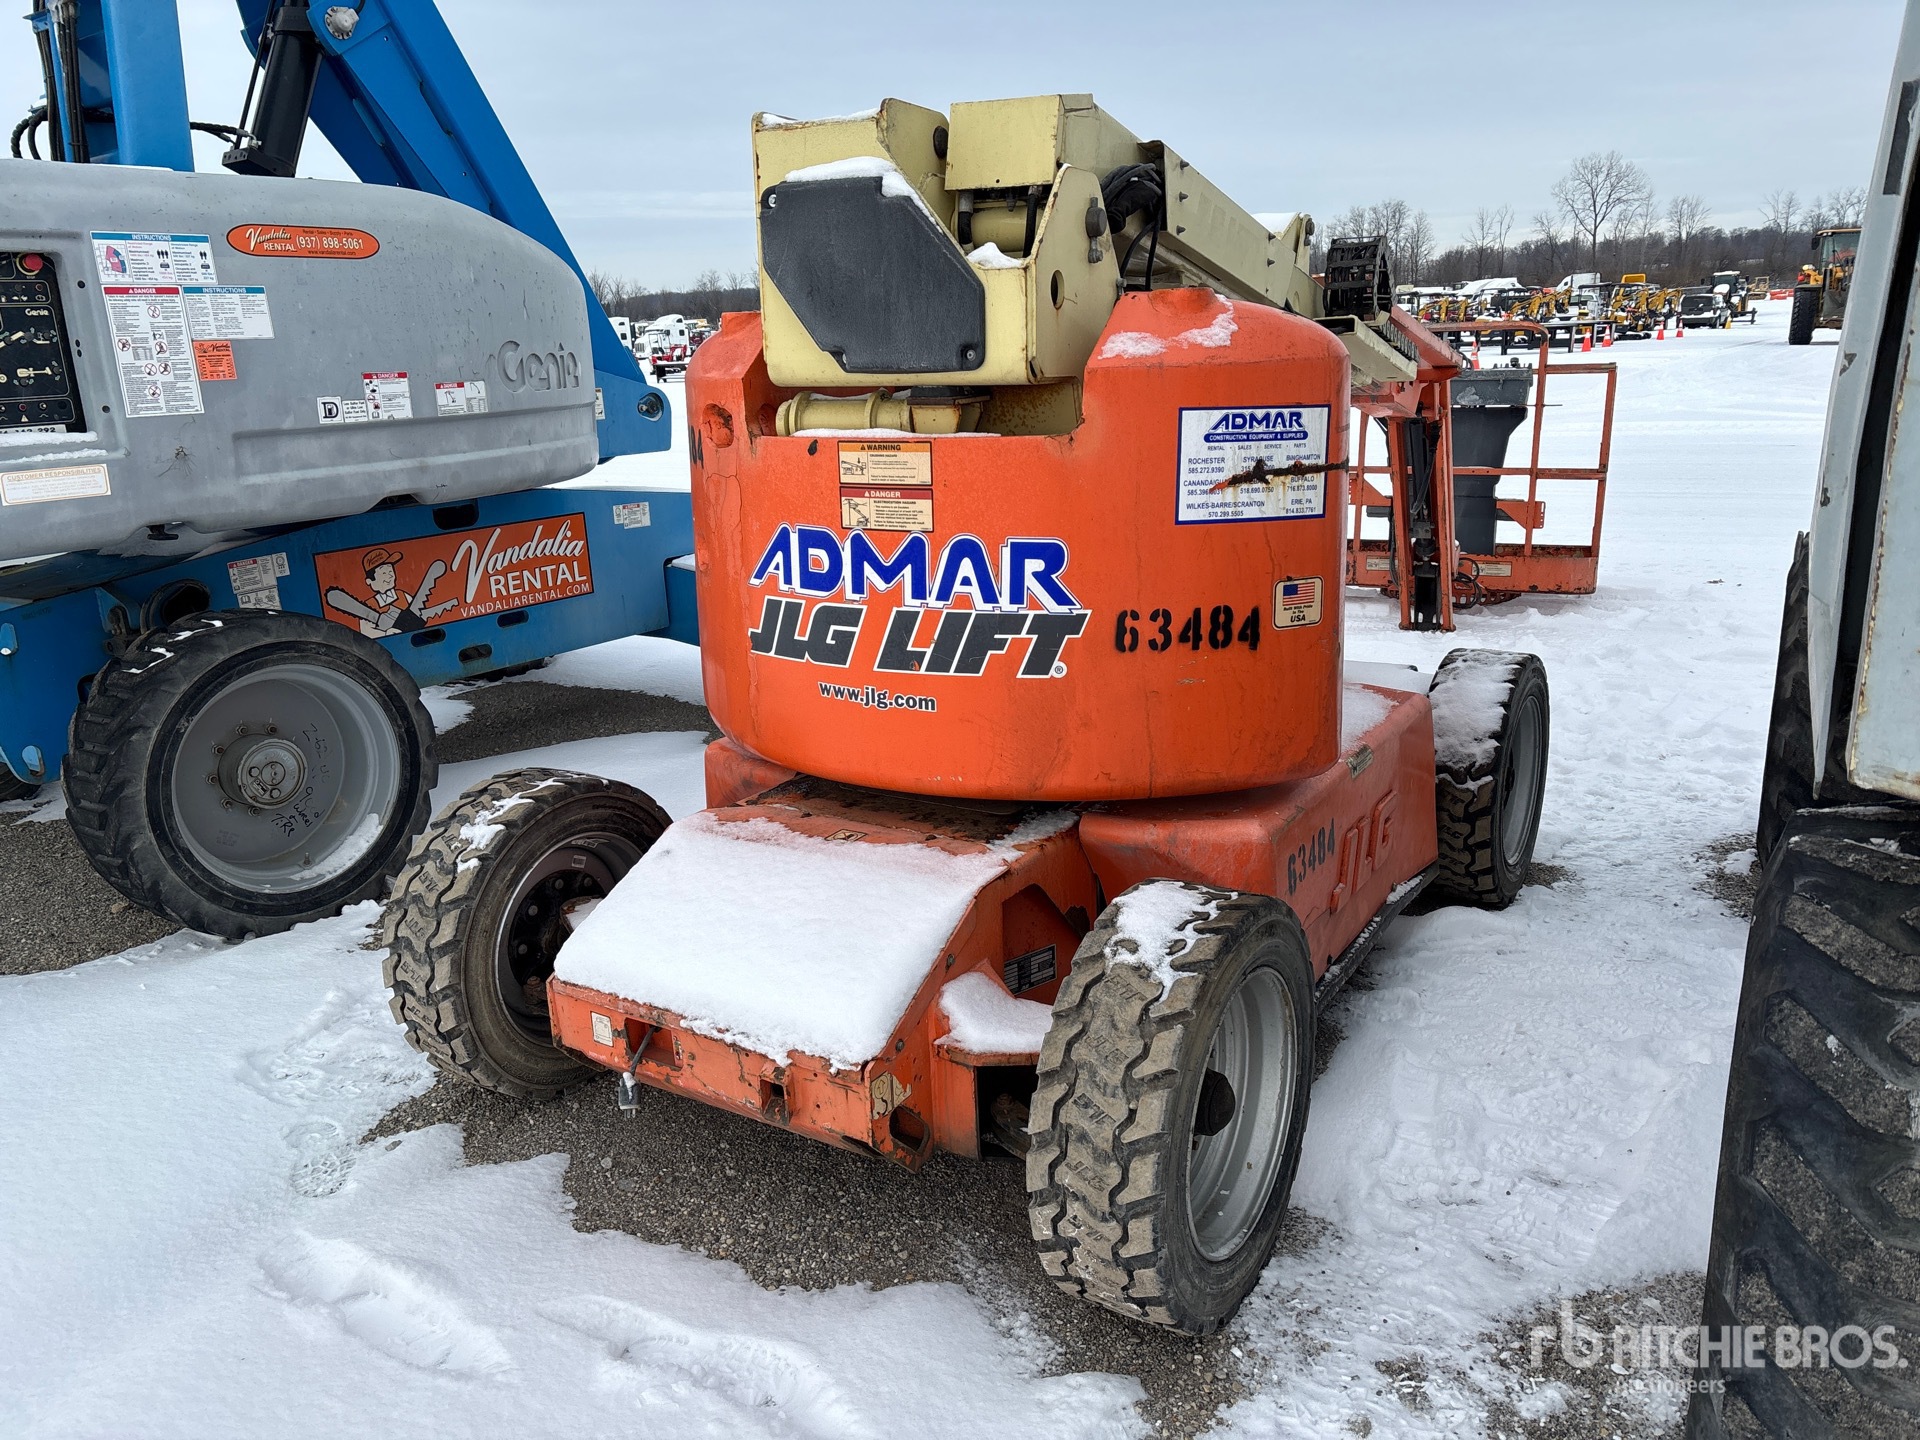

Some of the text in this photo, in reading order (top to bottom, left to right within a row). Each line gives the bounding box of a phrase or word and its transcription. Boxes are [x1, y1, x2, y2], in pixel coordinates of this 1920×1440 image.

[246, 227, 292, 251] Vandalia
[263, 242, 297, 252] RENTAL
[296, 234, 364, 250] (937) 898-5061
[25, 308, 50, 316] Genie
[497, 340, 580, 393] Genie
[1209, 411, 1306, 432] ADMAR
[7, 467, 102, 482] CUSTOMER RESPONSIBILITIES
[870, 490, 901, 498] DANGER
[1186, 501, 1265, 510] WILKES-BARRE/SCRANTON
[451, 519, 585, 604] Vandalia
[748, 522, 1084, 614] ADMAR
[488, 560, 588, 598] RENTAL
[460, 582, 591, 618] VANDALIARENTAL.COM
[1115, 604, 1261, 653] 63484
[1290, 614, 1306, 623] USA
[749, 595, 1093, 679] JLG LIFT
[818, 681, 938, 713] www.jlg.com
[1287, 817, 1336, 896] 63484
